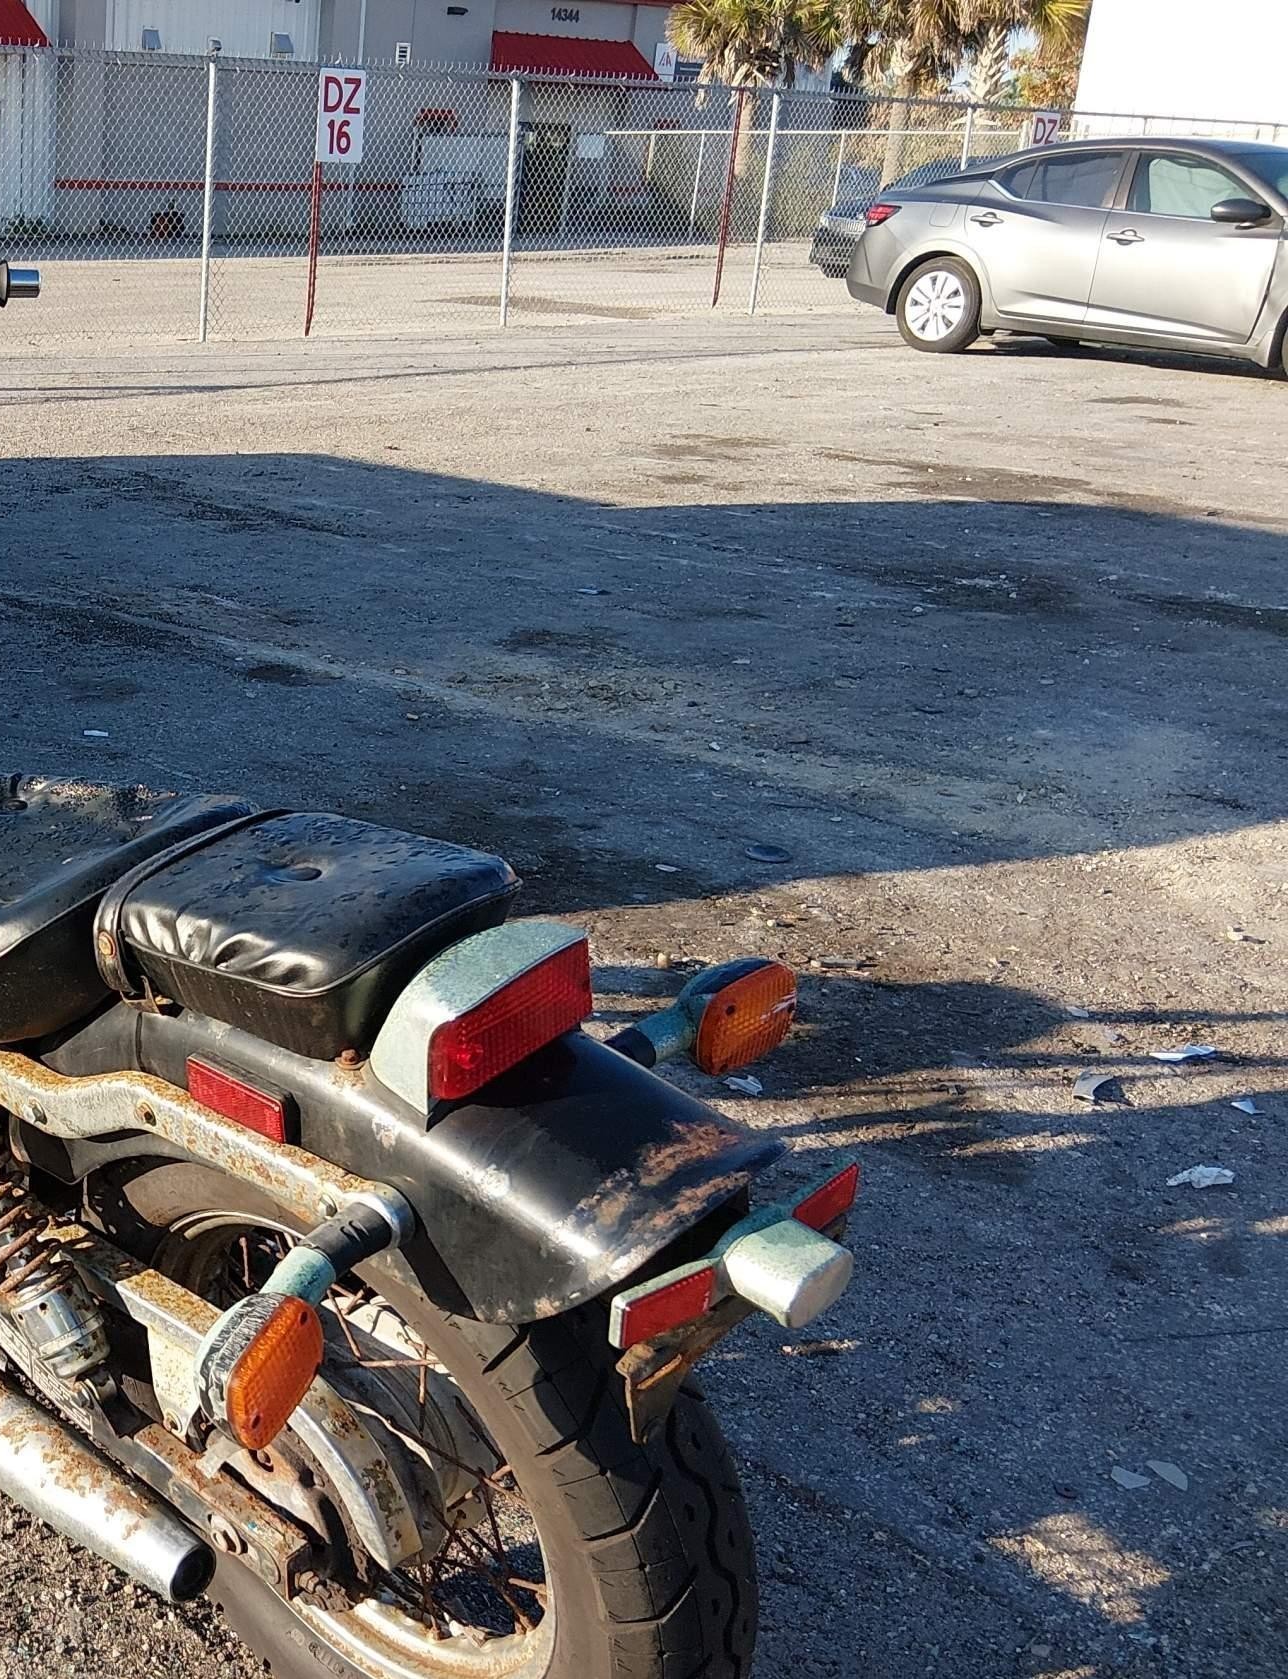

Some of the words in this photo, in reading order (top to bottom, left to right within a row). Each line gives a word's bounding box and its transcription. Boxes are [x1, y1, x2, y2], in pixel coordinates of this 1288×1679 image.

[550, 7, 580, 23] 14344
[323, 75, 362, 115] DZ
[327, 118, 352, 155] 16
[1032, 117, 1058, 145] DZ
